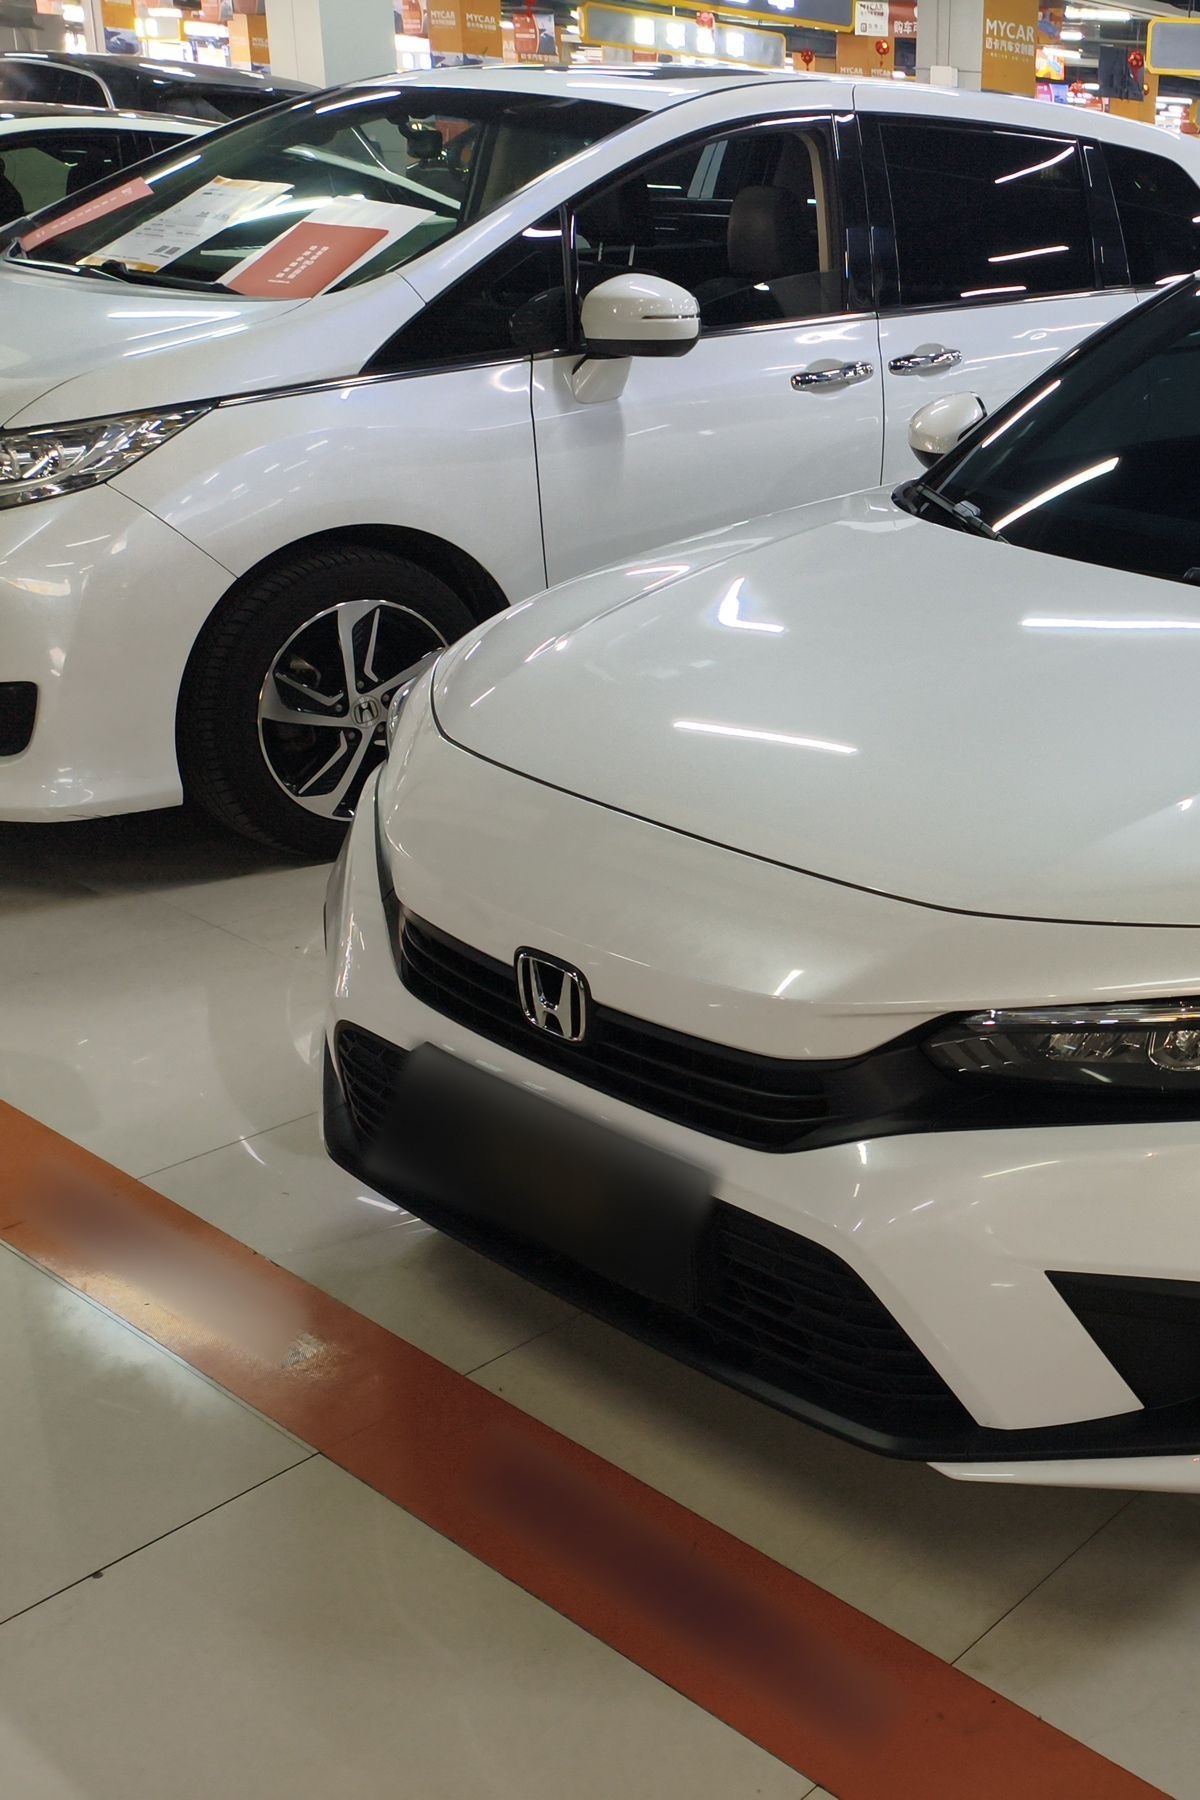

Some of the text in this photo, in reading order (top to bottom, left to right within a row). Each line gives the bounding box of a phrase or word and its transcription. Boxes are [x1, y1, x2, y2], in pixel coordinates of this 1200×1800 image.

[430, 9, 456, 20] MYCAR
[465, 12, 496, 25] MYCAR
[985, 18, 1035, 43] MYCAR
